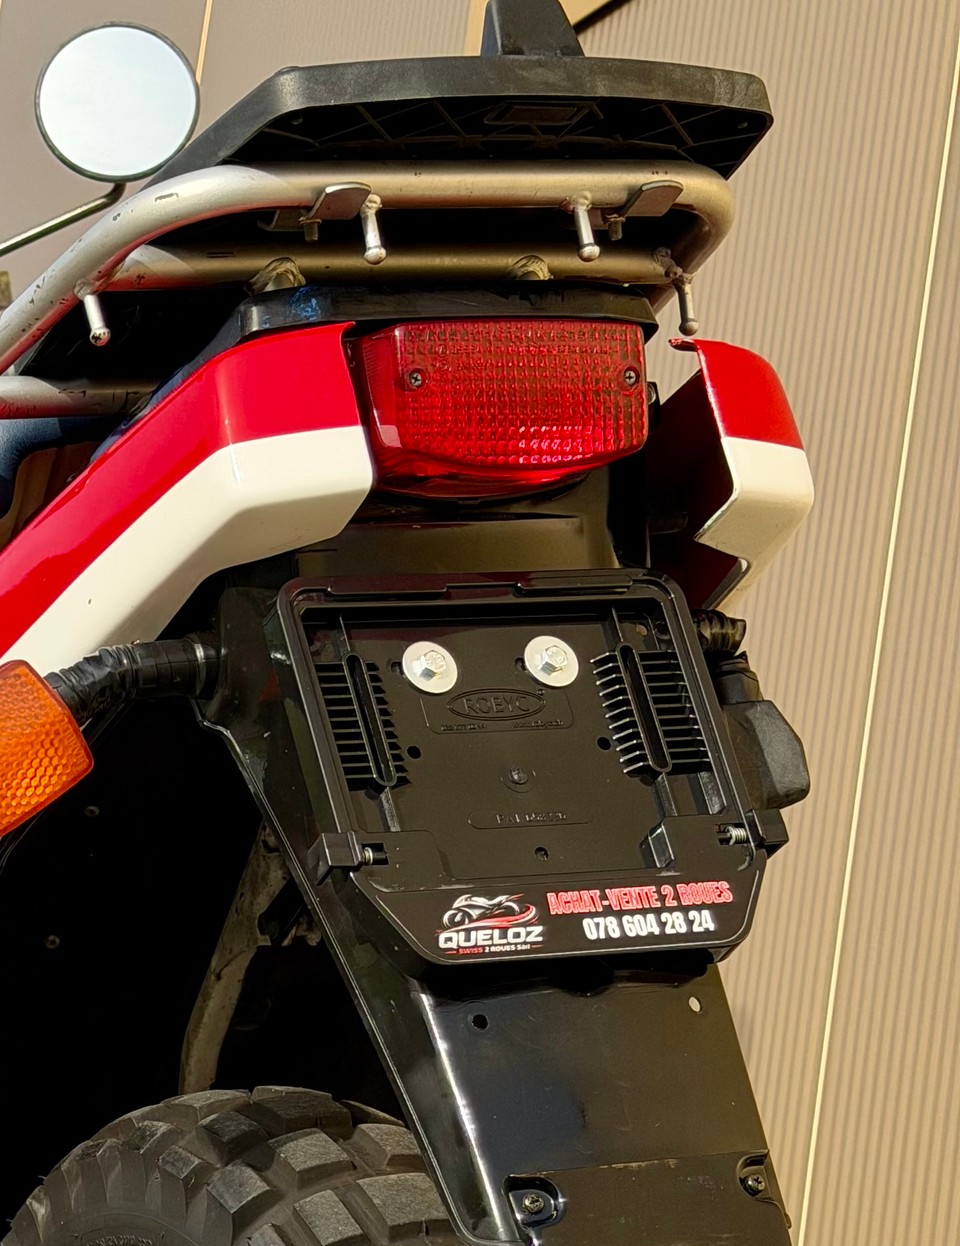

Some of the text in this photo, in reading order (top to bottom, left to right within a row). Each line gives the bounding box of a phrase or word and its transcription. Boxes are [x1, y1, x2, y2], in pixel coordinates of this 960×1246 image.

[546, 881, 734, 915] ACHAT-VENTE 2 ROUES
[438, 925, 544, 949] QUELOZ
[582, 909, 715, 940] 078 604 28 24
[458, 947, 483, 955] SWISS
[490, 944, 516, 952] ROUES
